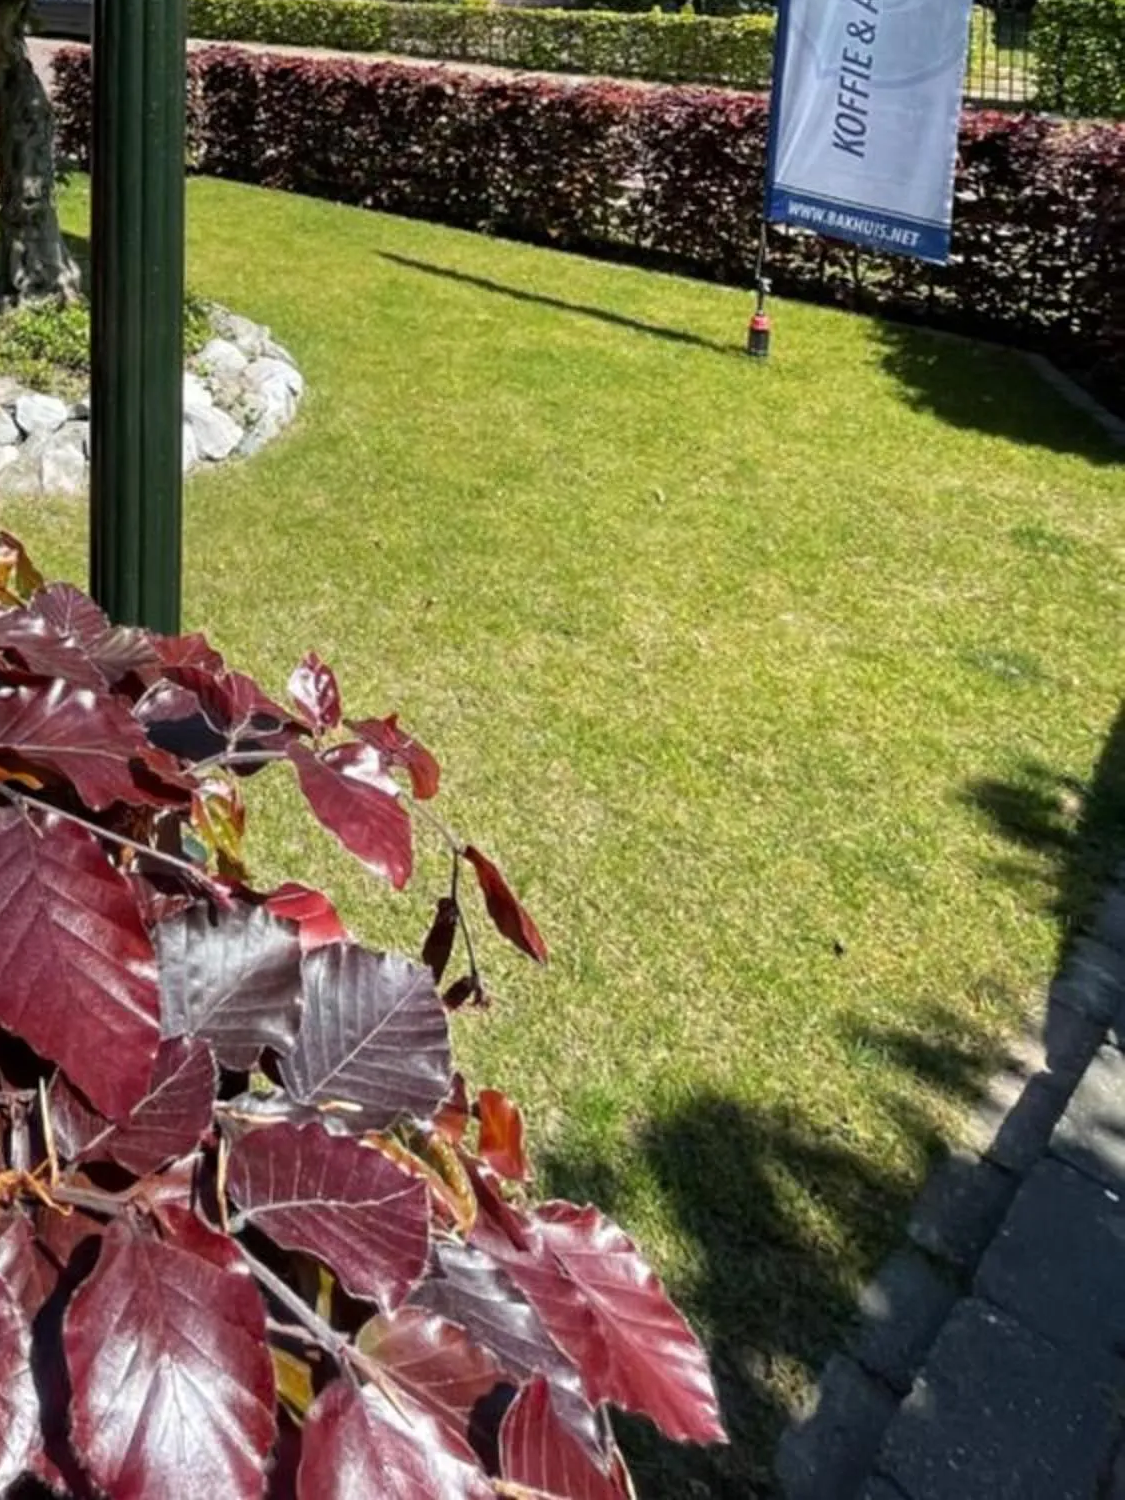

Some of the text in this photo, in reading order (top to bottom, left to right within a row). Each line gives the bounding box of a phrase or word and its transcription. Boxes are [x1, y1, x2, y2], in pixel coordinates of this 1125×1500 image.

[846, 19, 876, 45] &
[832, 47, 873, 158] KOFFIE
[786, 200, 921, 247] WWW.BAKHUIS.NET
